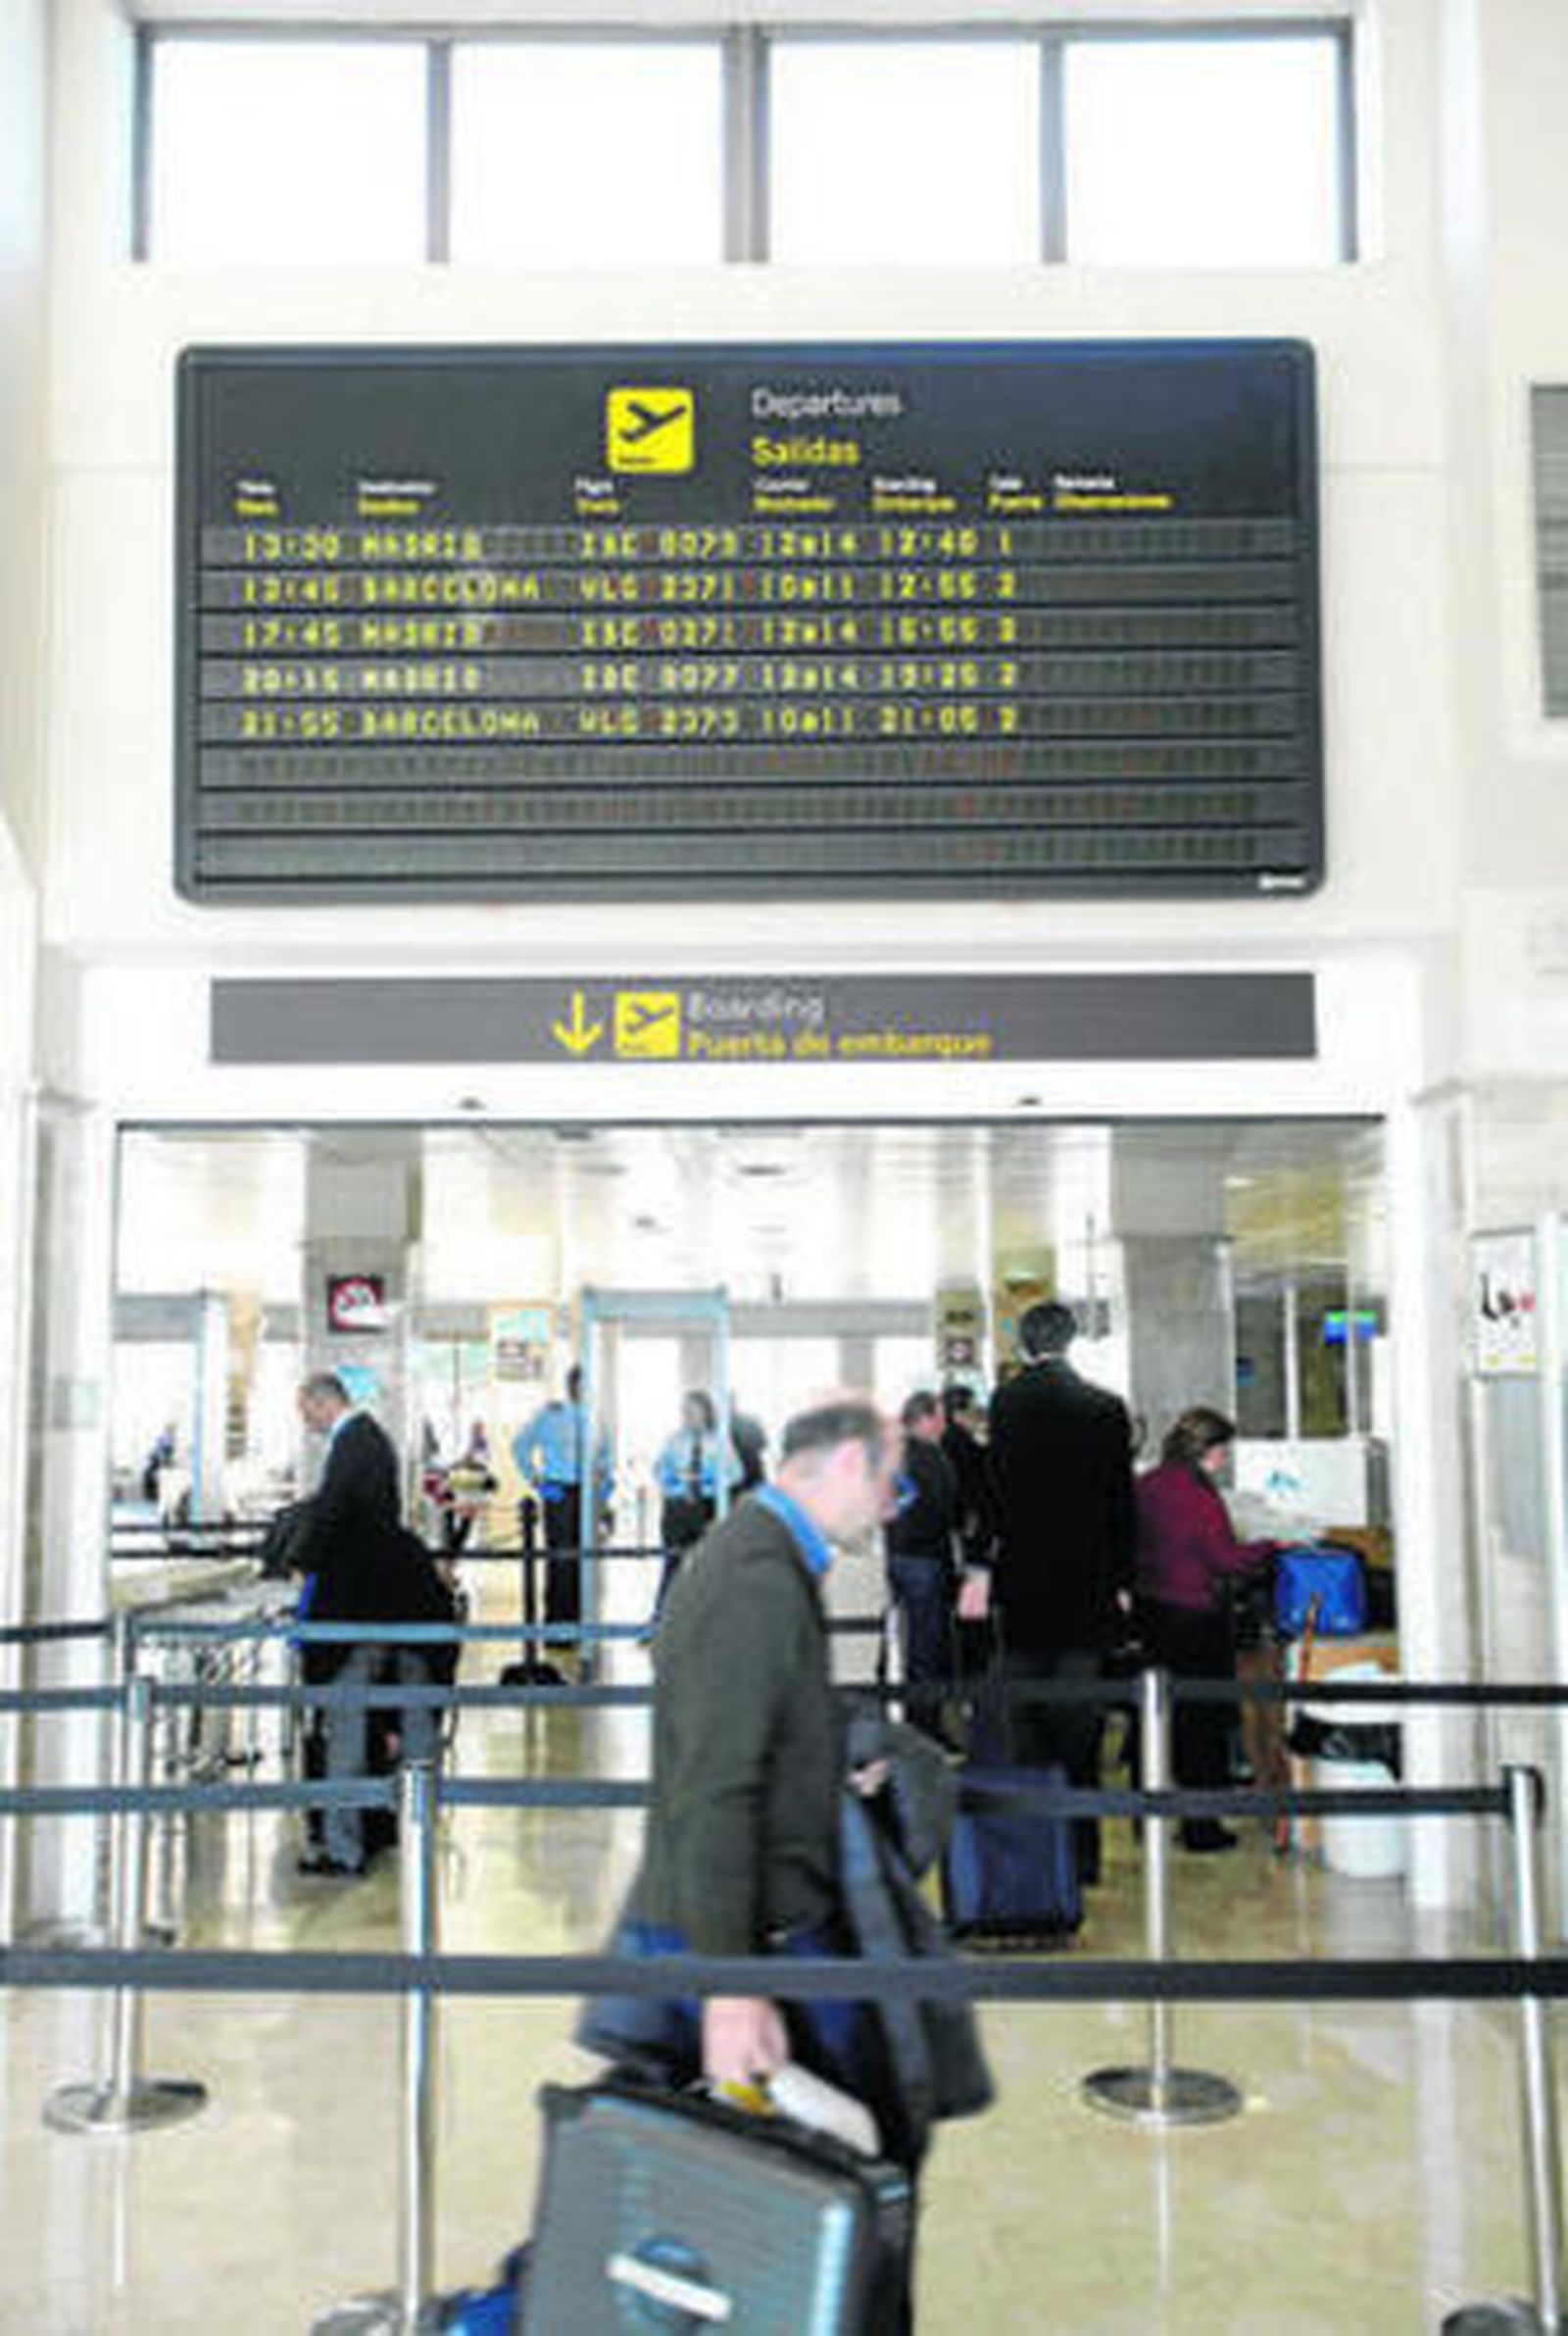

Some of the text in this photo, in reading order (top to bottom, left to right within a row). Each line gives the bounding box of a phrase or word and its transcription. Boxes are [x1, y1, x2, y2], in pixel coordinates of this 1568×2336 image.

[752, 386, 904, 420] Departures
[751, 435, 861, 466] Salidas
[1000, 527, 1012, 556] 1
[689, 992, 825, 1025] Boarding
[688, 1027, 992, 1061] Puerta de embarque
